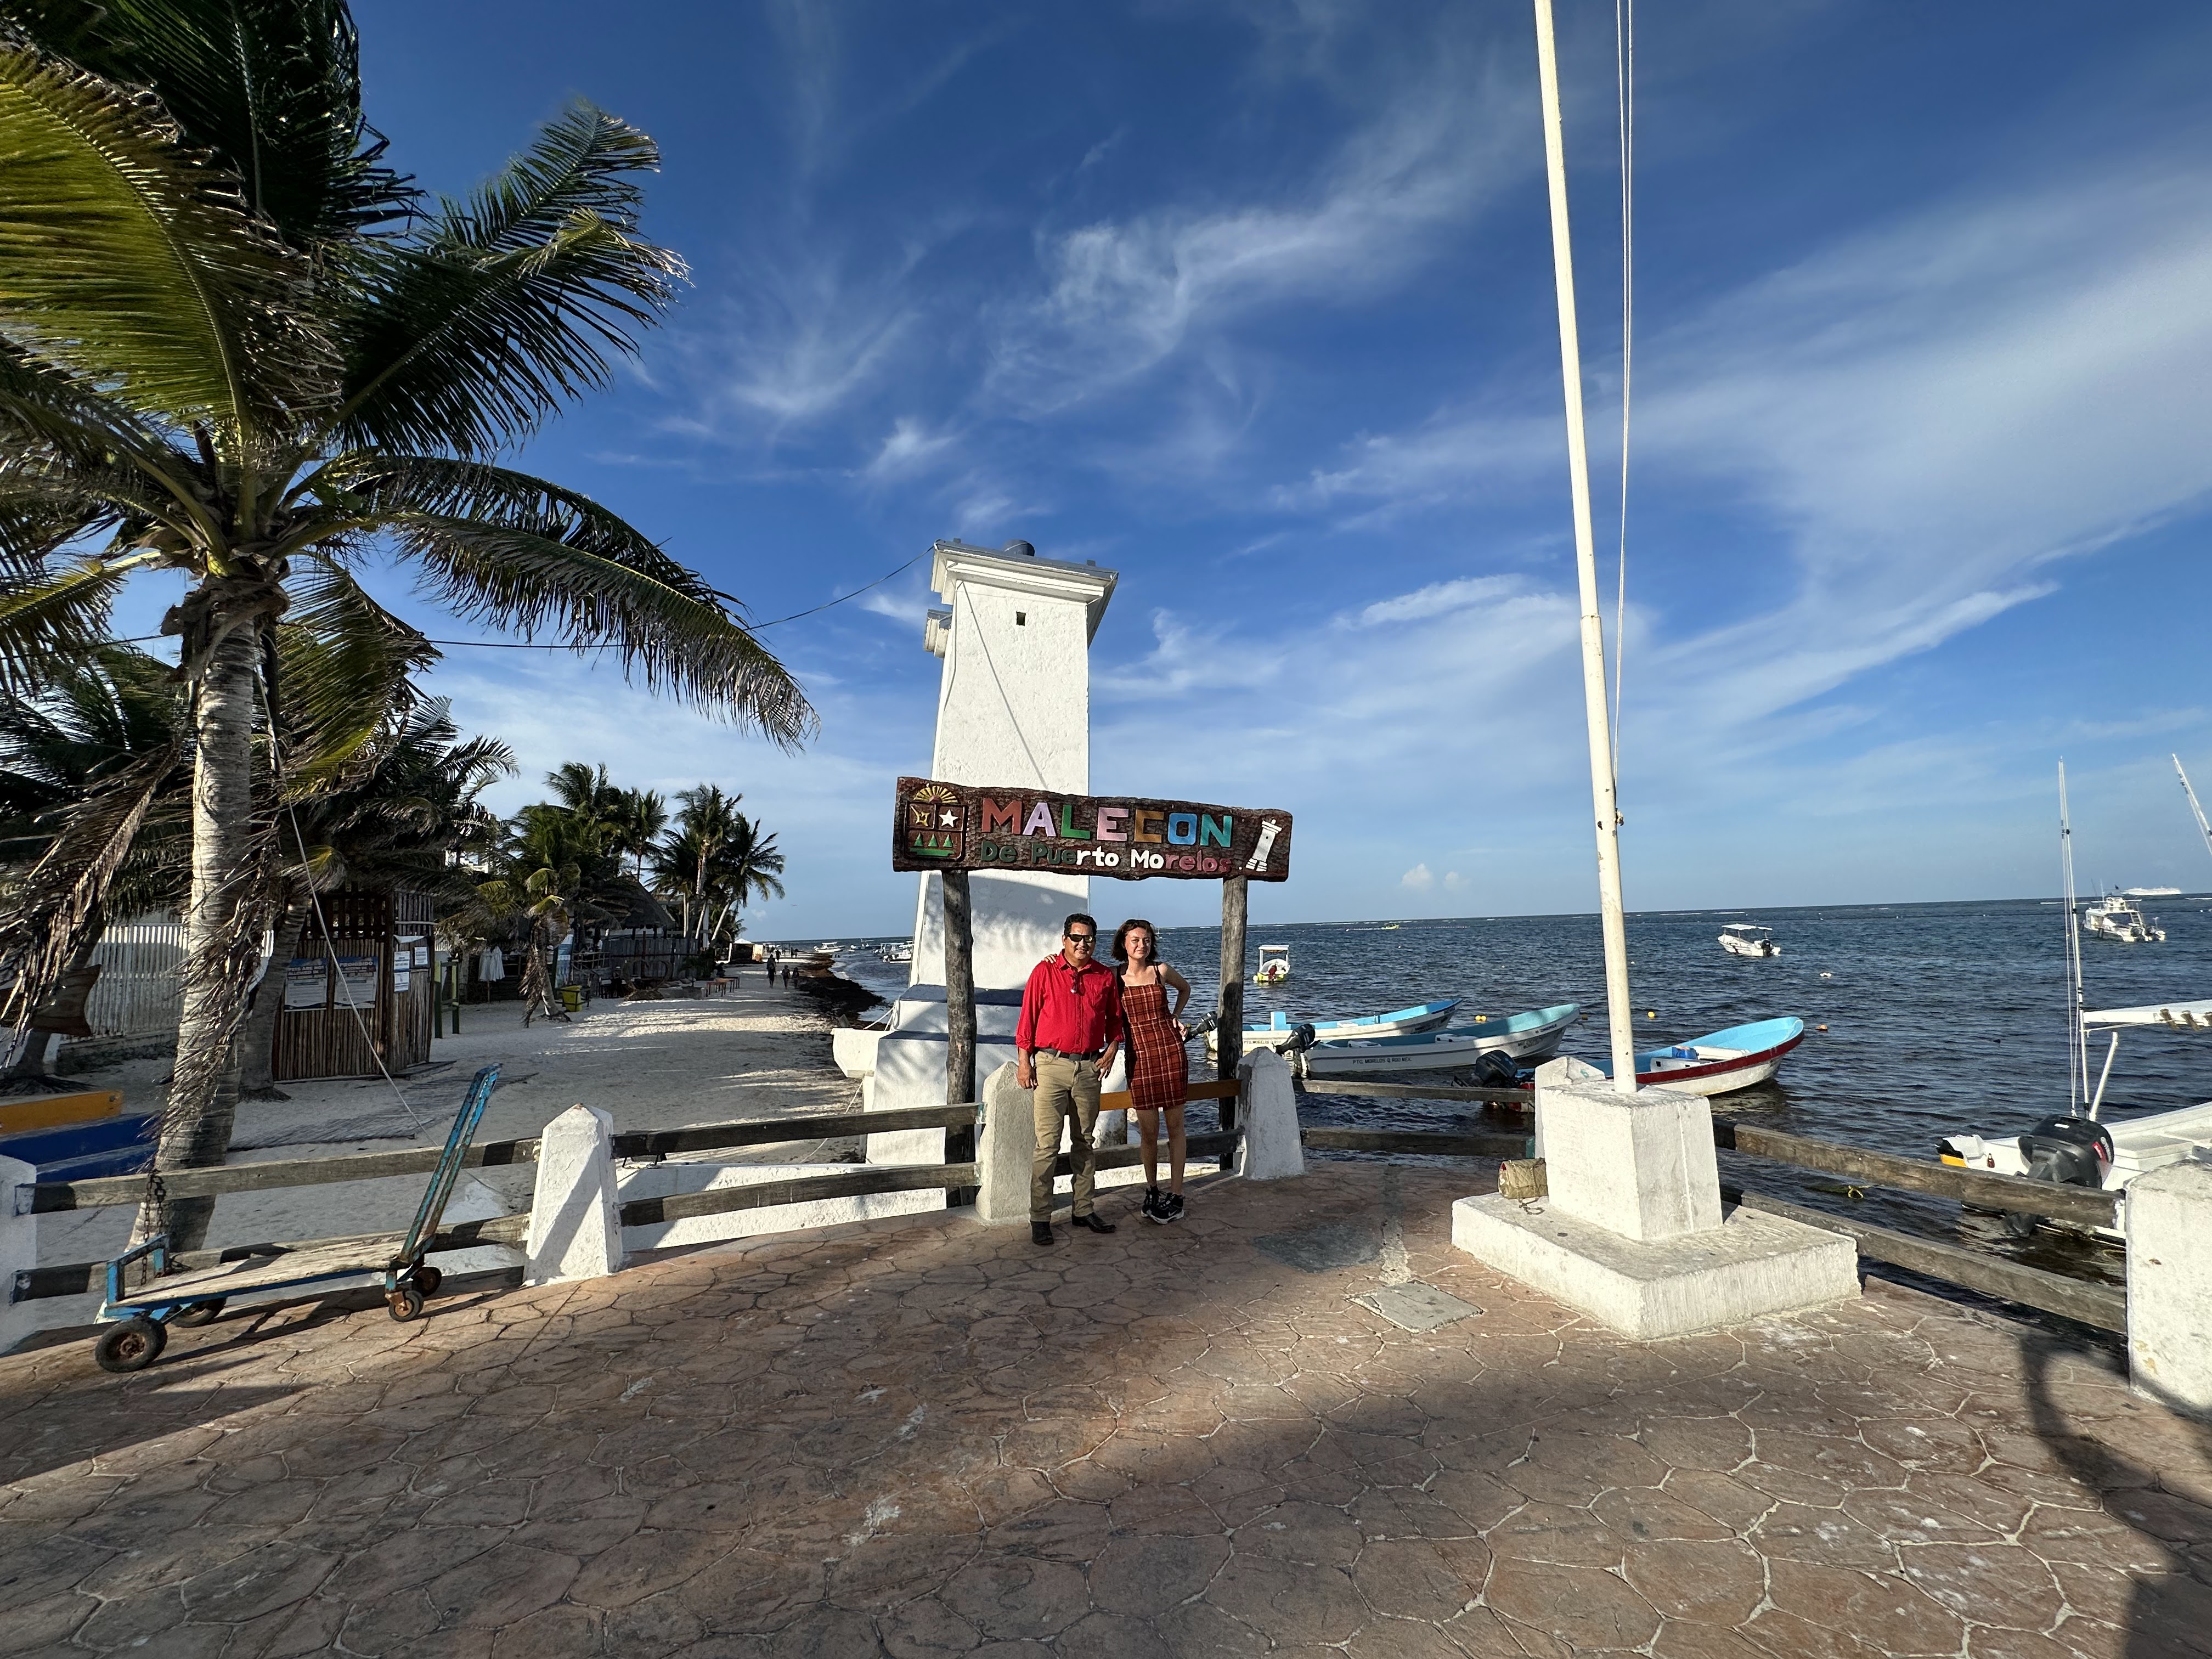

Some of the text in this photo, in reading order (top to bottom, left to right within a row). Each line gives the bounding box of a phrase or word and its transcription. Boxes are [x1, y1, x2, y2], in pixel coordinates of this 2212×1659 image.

[981, 798, 1233, 848] MALECON
[980, 840, 1233, 873] De Puerto Morelos
